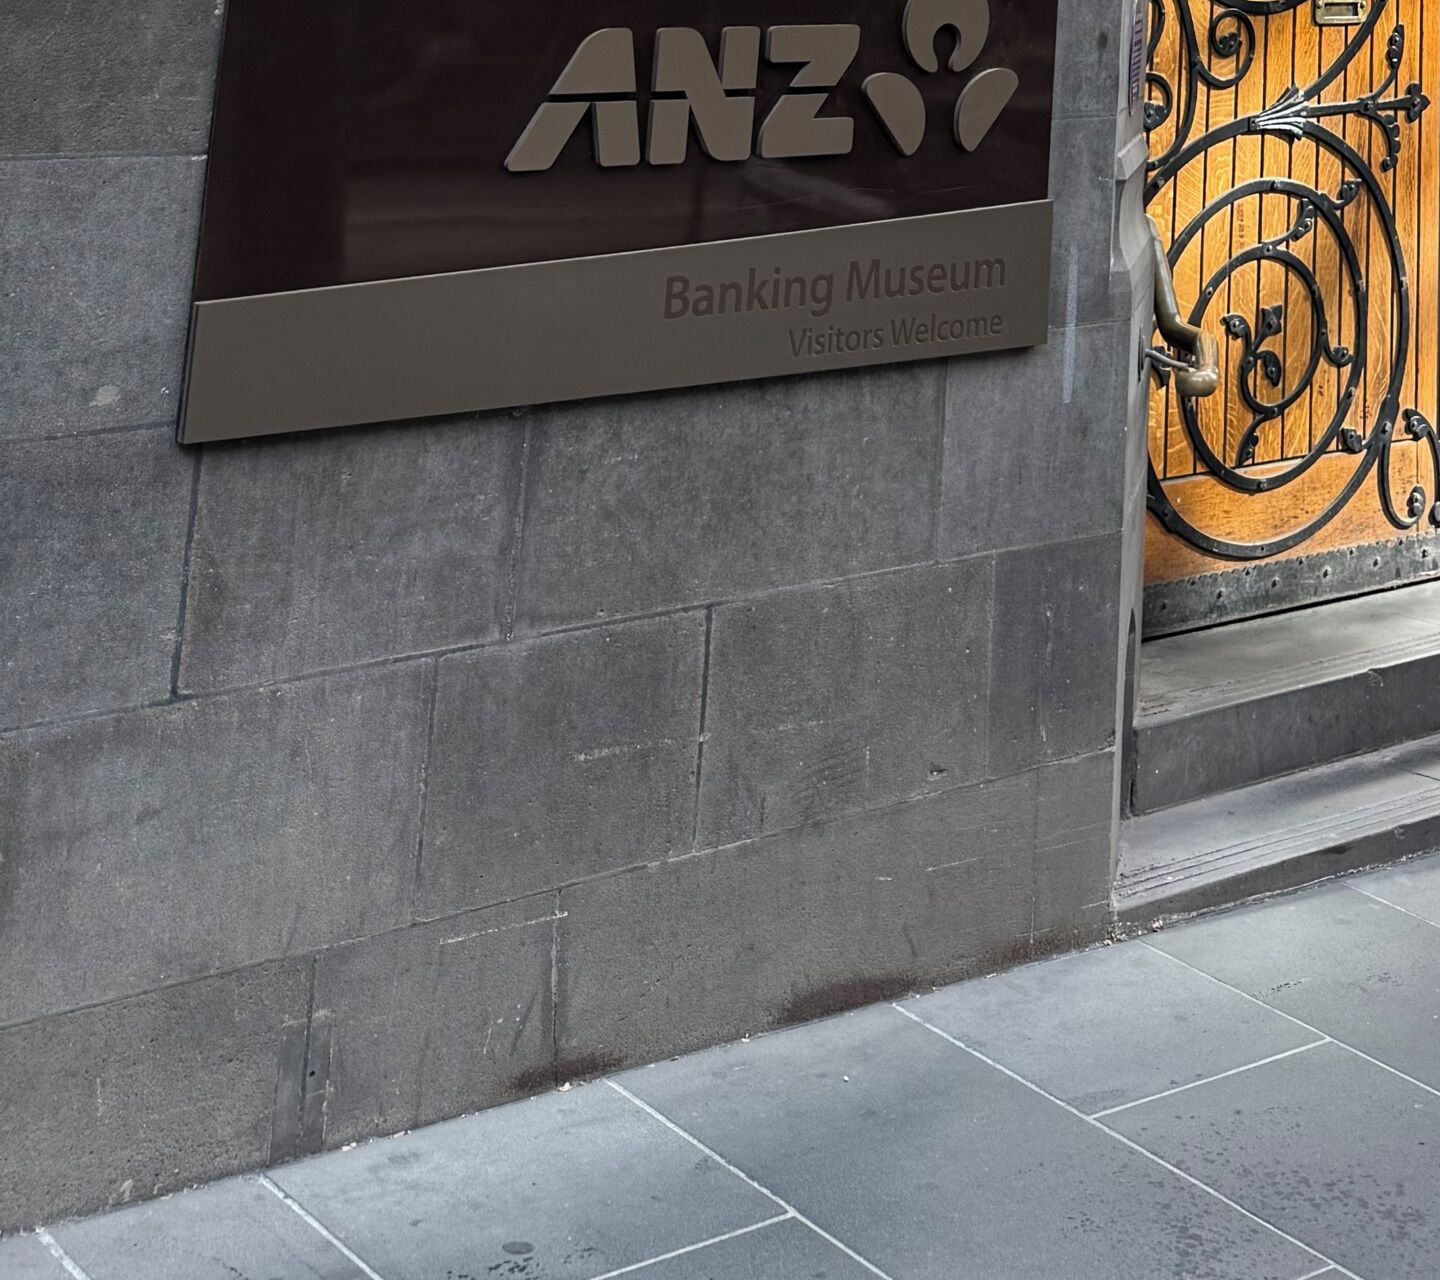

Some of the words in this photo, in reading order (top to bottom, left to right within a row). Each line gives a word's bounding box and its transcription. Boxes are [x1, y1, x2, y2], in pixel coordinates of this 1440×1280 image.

[504, 24, 861, 172] ANZ
[664, 267, 835, 318] Banking
[846, 257, 1006, 303] Museum
[788, 324, 884, 358] Visitors
[890, 313, 1003, 348] Welcome
